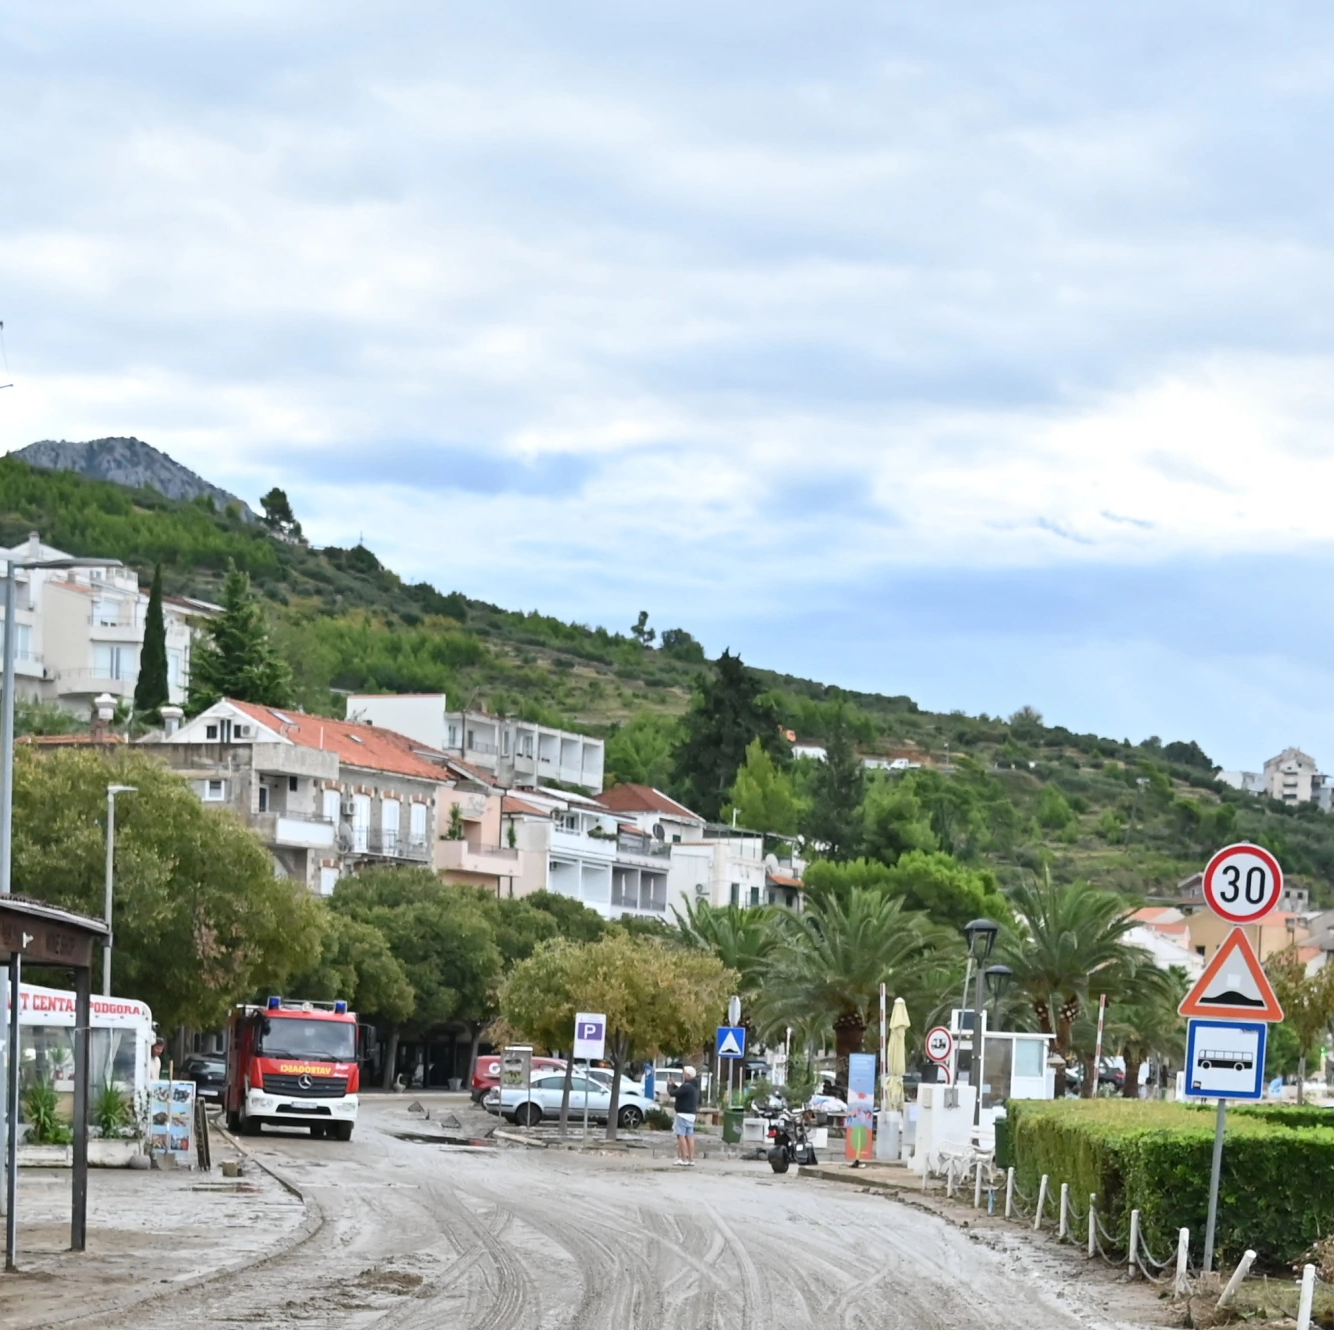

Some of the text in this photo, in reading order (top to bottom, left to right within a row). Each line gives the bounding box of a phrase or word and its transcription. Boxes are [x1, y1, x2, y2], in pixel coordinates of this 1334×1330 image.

[1220, 865, 1266, 905] 30
[33, 994, 77, 1012] CENTA
[583, 1024, 596, 1039] P
